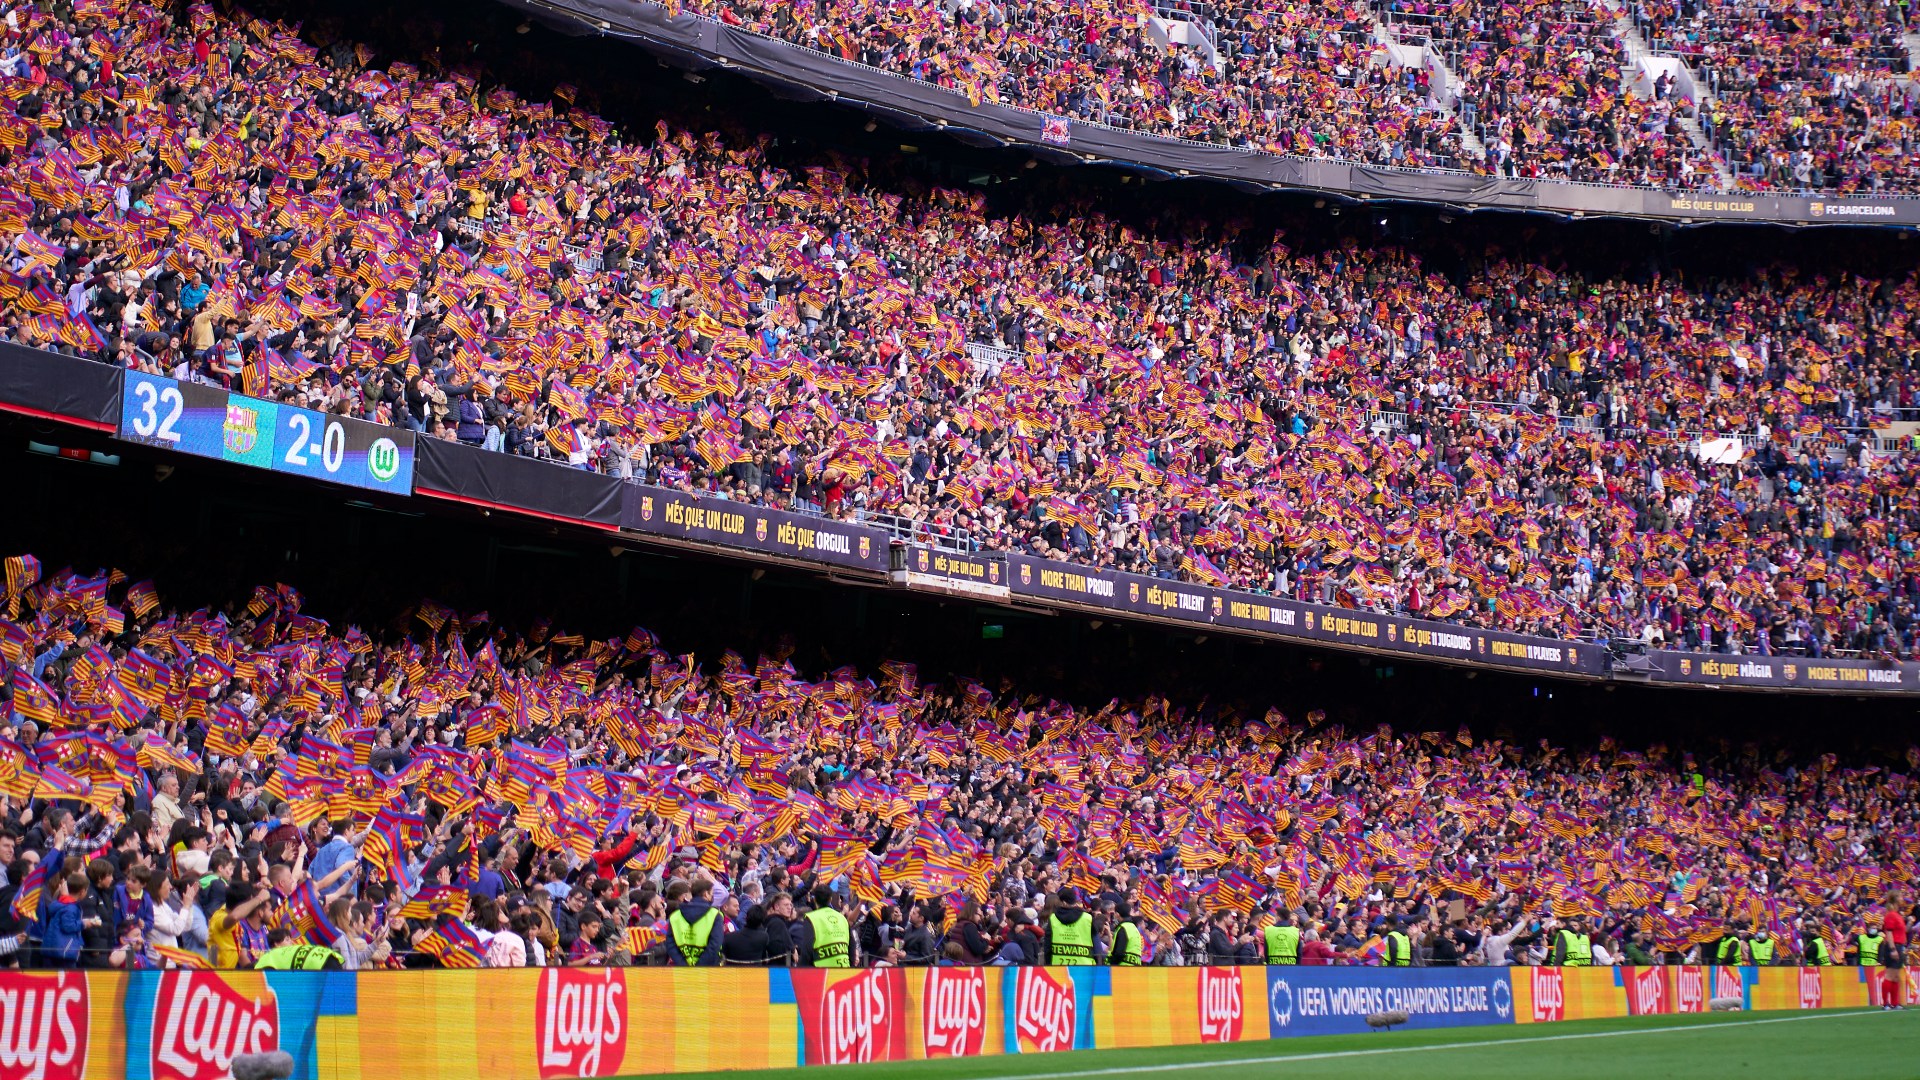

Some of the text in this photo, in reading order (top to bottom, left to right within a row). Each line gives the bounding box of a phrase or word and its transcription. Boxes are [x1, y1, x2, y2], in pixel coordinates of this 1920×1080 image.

[1671, 198, 1754, 212] MÉS QUE UN CLUB
[1826, 205, 1896, 215] FC BARCELONA
[133, 381, 183, 442] 32
[285, 413, 345, 473] 2-0
[665, 499, 745, 535] MÉS QUE UN CLUB
[777, 520, 851, 554] MÉS QUE ORGULL
[934, 555, 947, 571] MÉS
[960, 561, 969, 575] UN
[970, 562, 984, 578] CLUB
[1041, 569, 1114, 597] MORE THAN PROUD
[1147, 584, 1205, 612] MÉS QUE TALENT
[1230, 601, 1296, 626] MORE THAN TALENT
[1321, 612, 1378, 638] MÉS QUE UN CLUB
[1403, 625, 1472, 651] MÉS QUE 11 JUGADORS
[1491, 641, 1562, 662] MORE THAN 11 PLAYERS
[1701, 659, 1773, 679] MÉS QUE MÀGIA
[1807, 667, 1902, 683] MORE THAN MAGIC
[818, 943, 849, 959] STEW
[1051, 945, 1089, 956] TEWARD
[1269, 956, 1297, 965] STEWARD
[1202, 966, 1241, 1042] Lay's
[1298, 986, 1489, 1016] UEFA WOMEN'S CHAMPIONS LEAGUE
[1533, 966, 1562, 1021] Lay's
[1637, 966, 1661, 1015] Lays
[543, 966, 622, 1078] Lay's
[828, 967, 885, 1064] Lays
[928, 966, 982, 1057] Lay's
[1018, 966, 1073, 1052] Lay's
